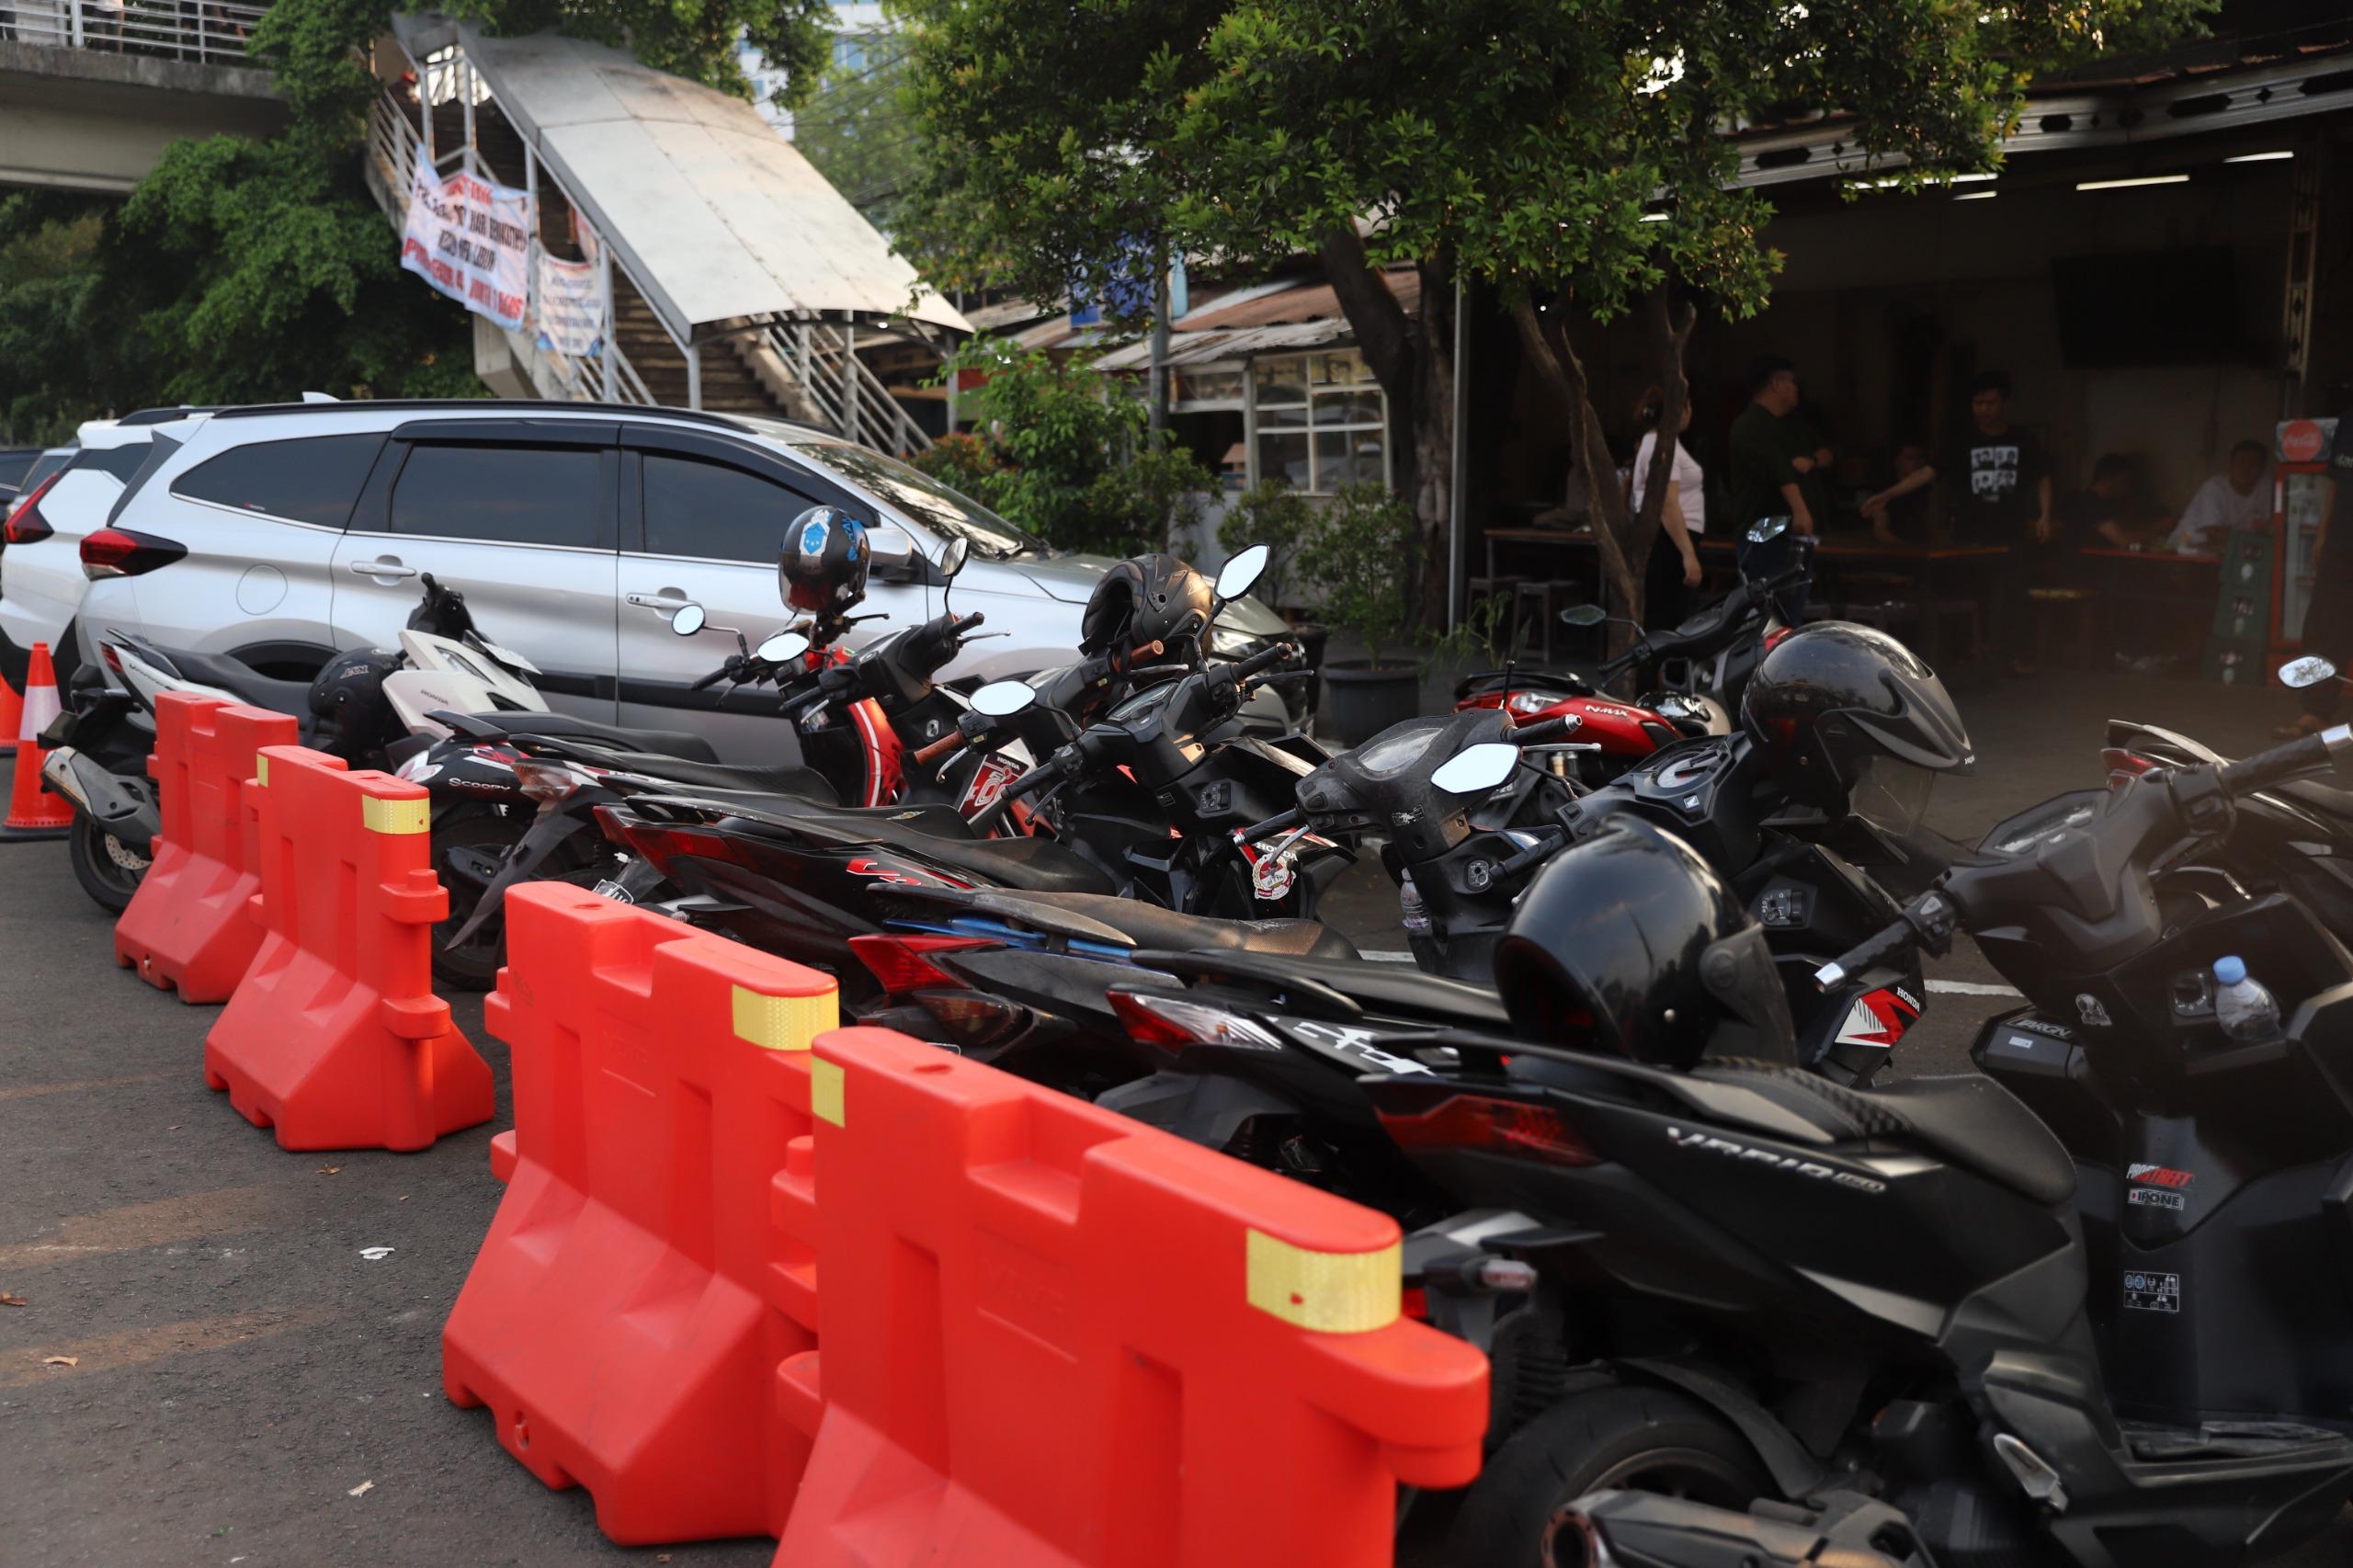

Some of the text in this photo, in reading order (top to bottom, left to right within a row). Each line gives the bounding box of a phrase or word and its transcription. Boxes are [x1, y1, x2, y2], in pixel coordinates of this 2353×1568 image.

[420, 688, 449, 706] HONDA
[1585, 704, 1630, 717] NMAX
[996, 756, 1020, 771] HONDA
[1896, 986, 1920, 1013] HONDA
